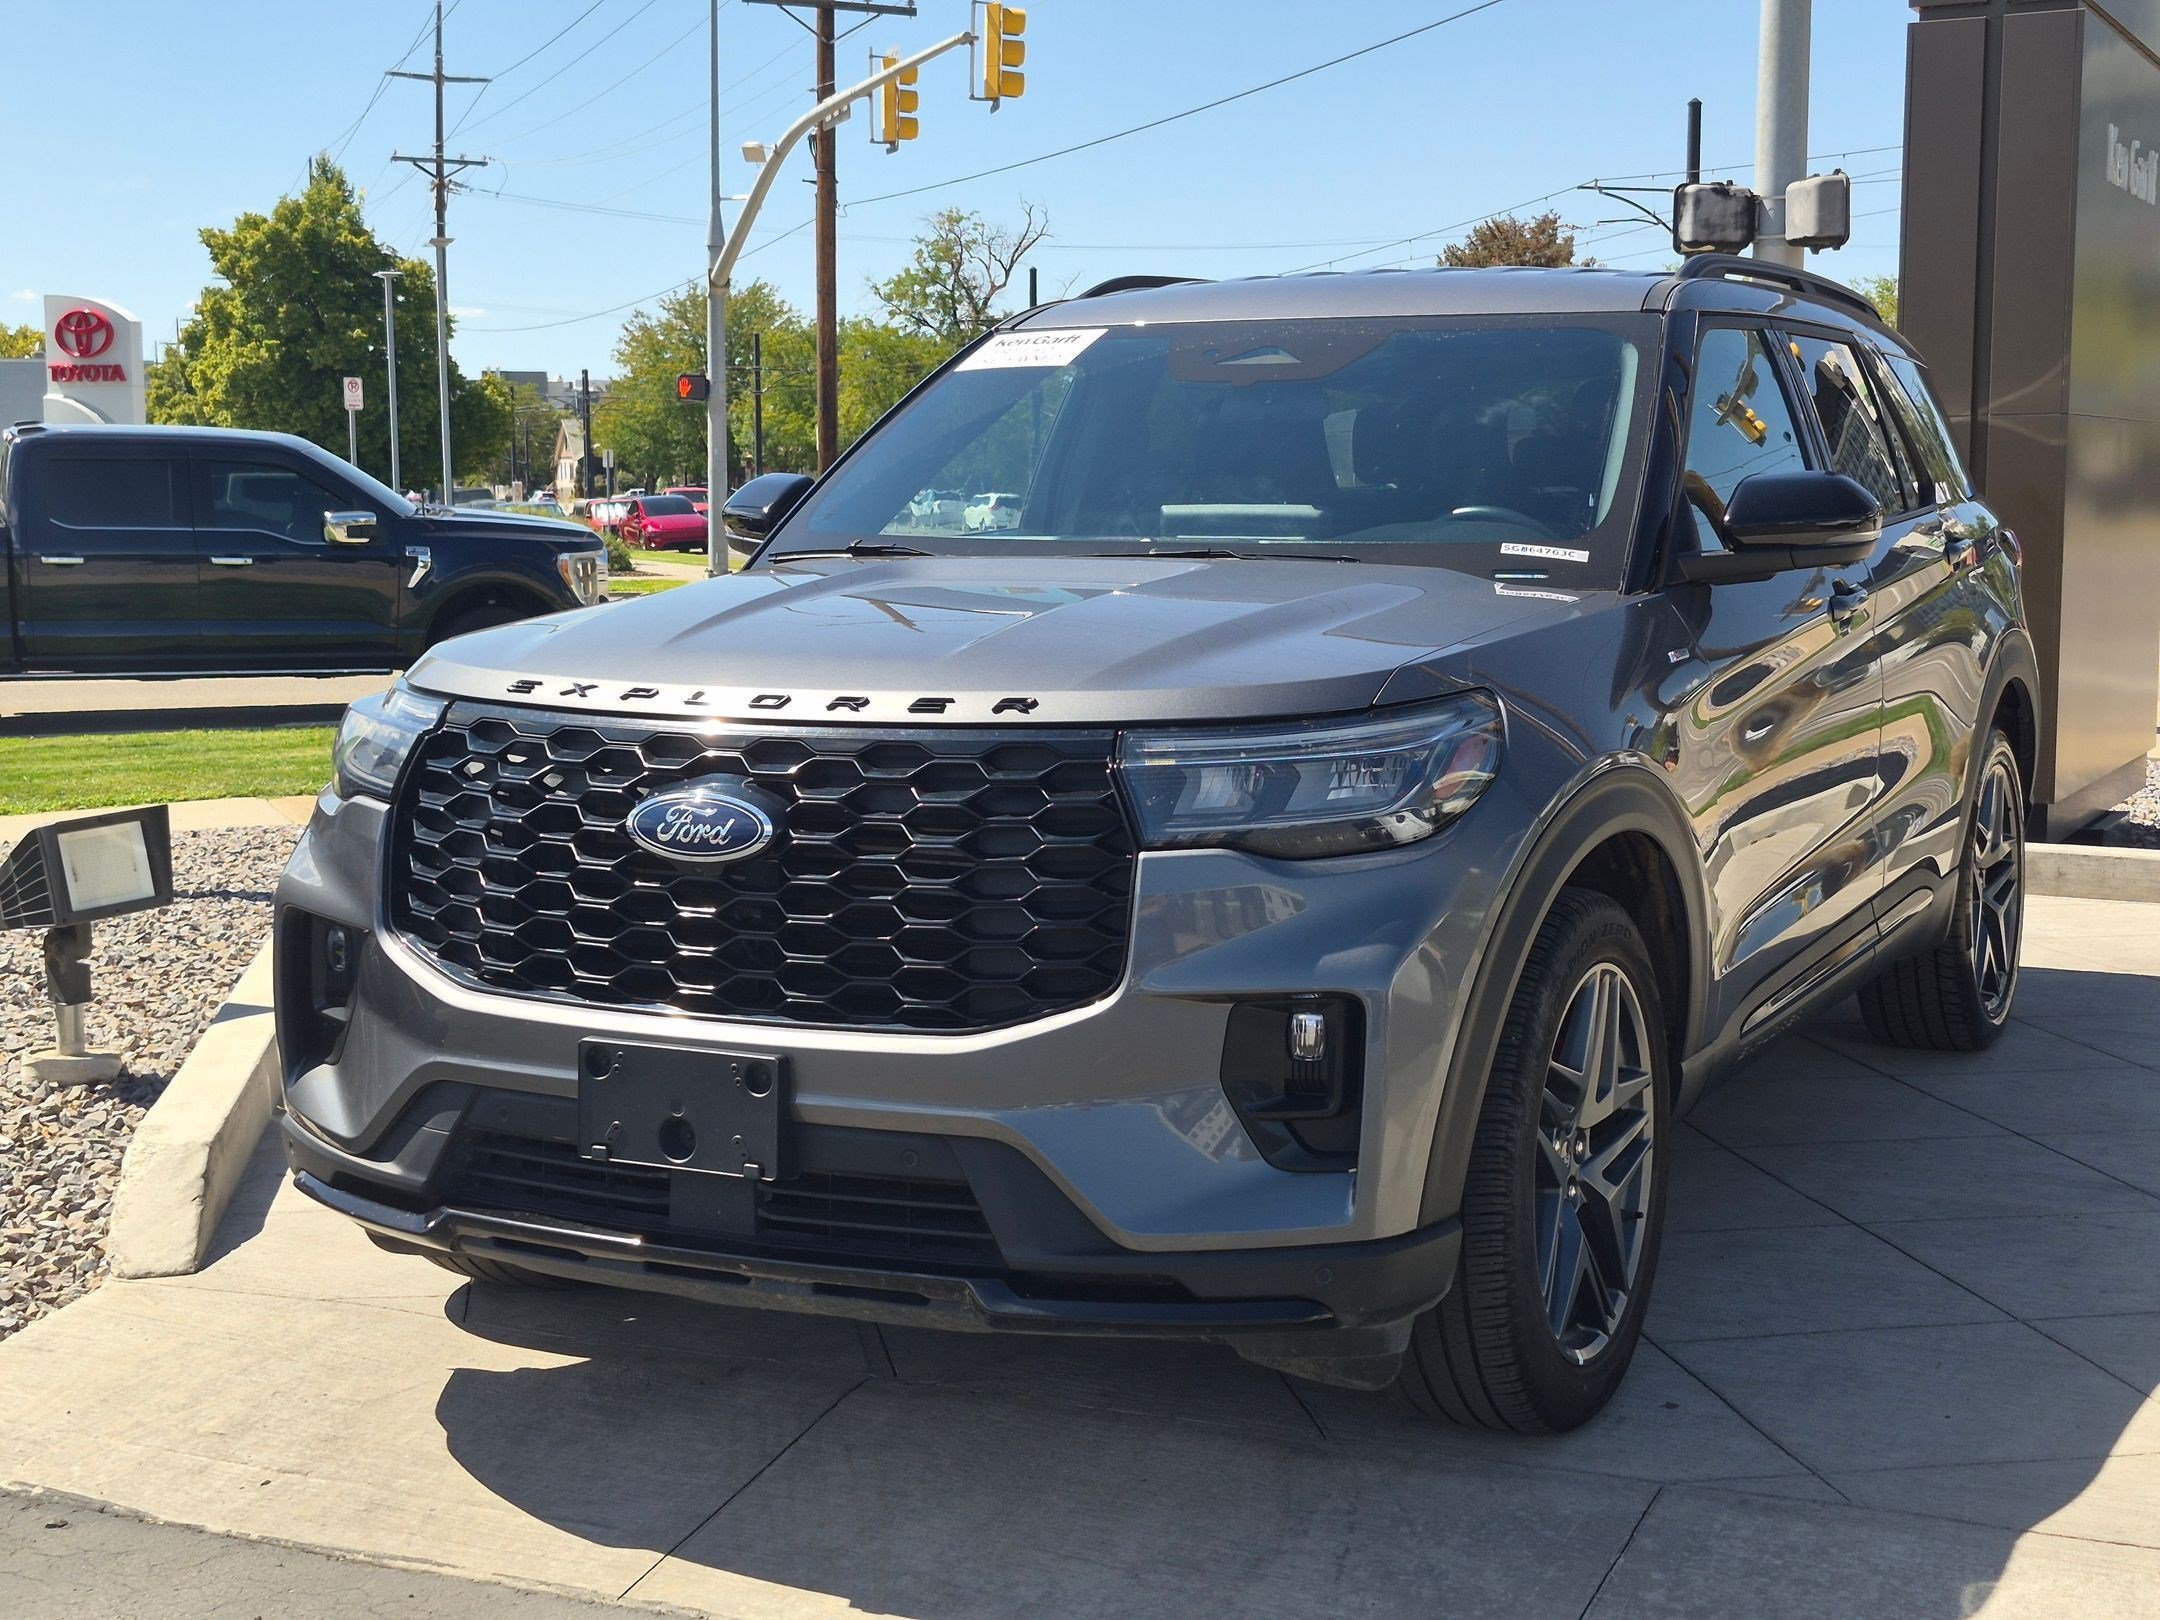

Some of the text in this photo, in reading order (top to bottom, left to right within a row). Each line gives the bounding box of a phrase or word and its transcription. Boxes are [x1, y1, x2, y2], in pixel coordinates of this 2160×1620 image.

[993, 335, 1032, 348] Ken
[48, 362, 127, 383] TOYOTA
[506, 679, 1040, 715] EXPLORER
[656, 805, 736, 847] Ford
[1601, 922, 1632, 940] ZERO
